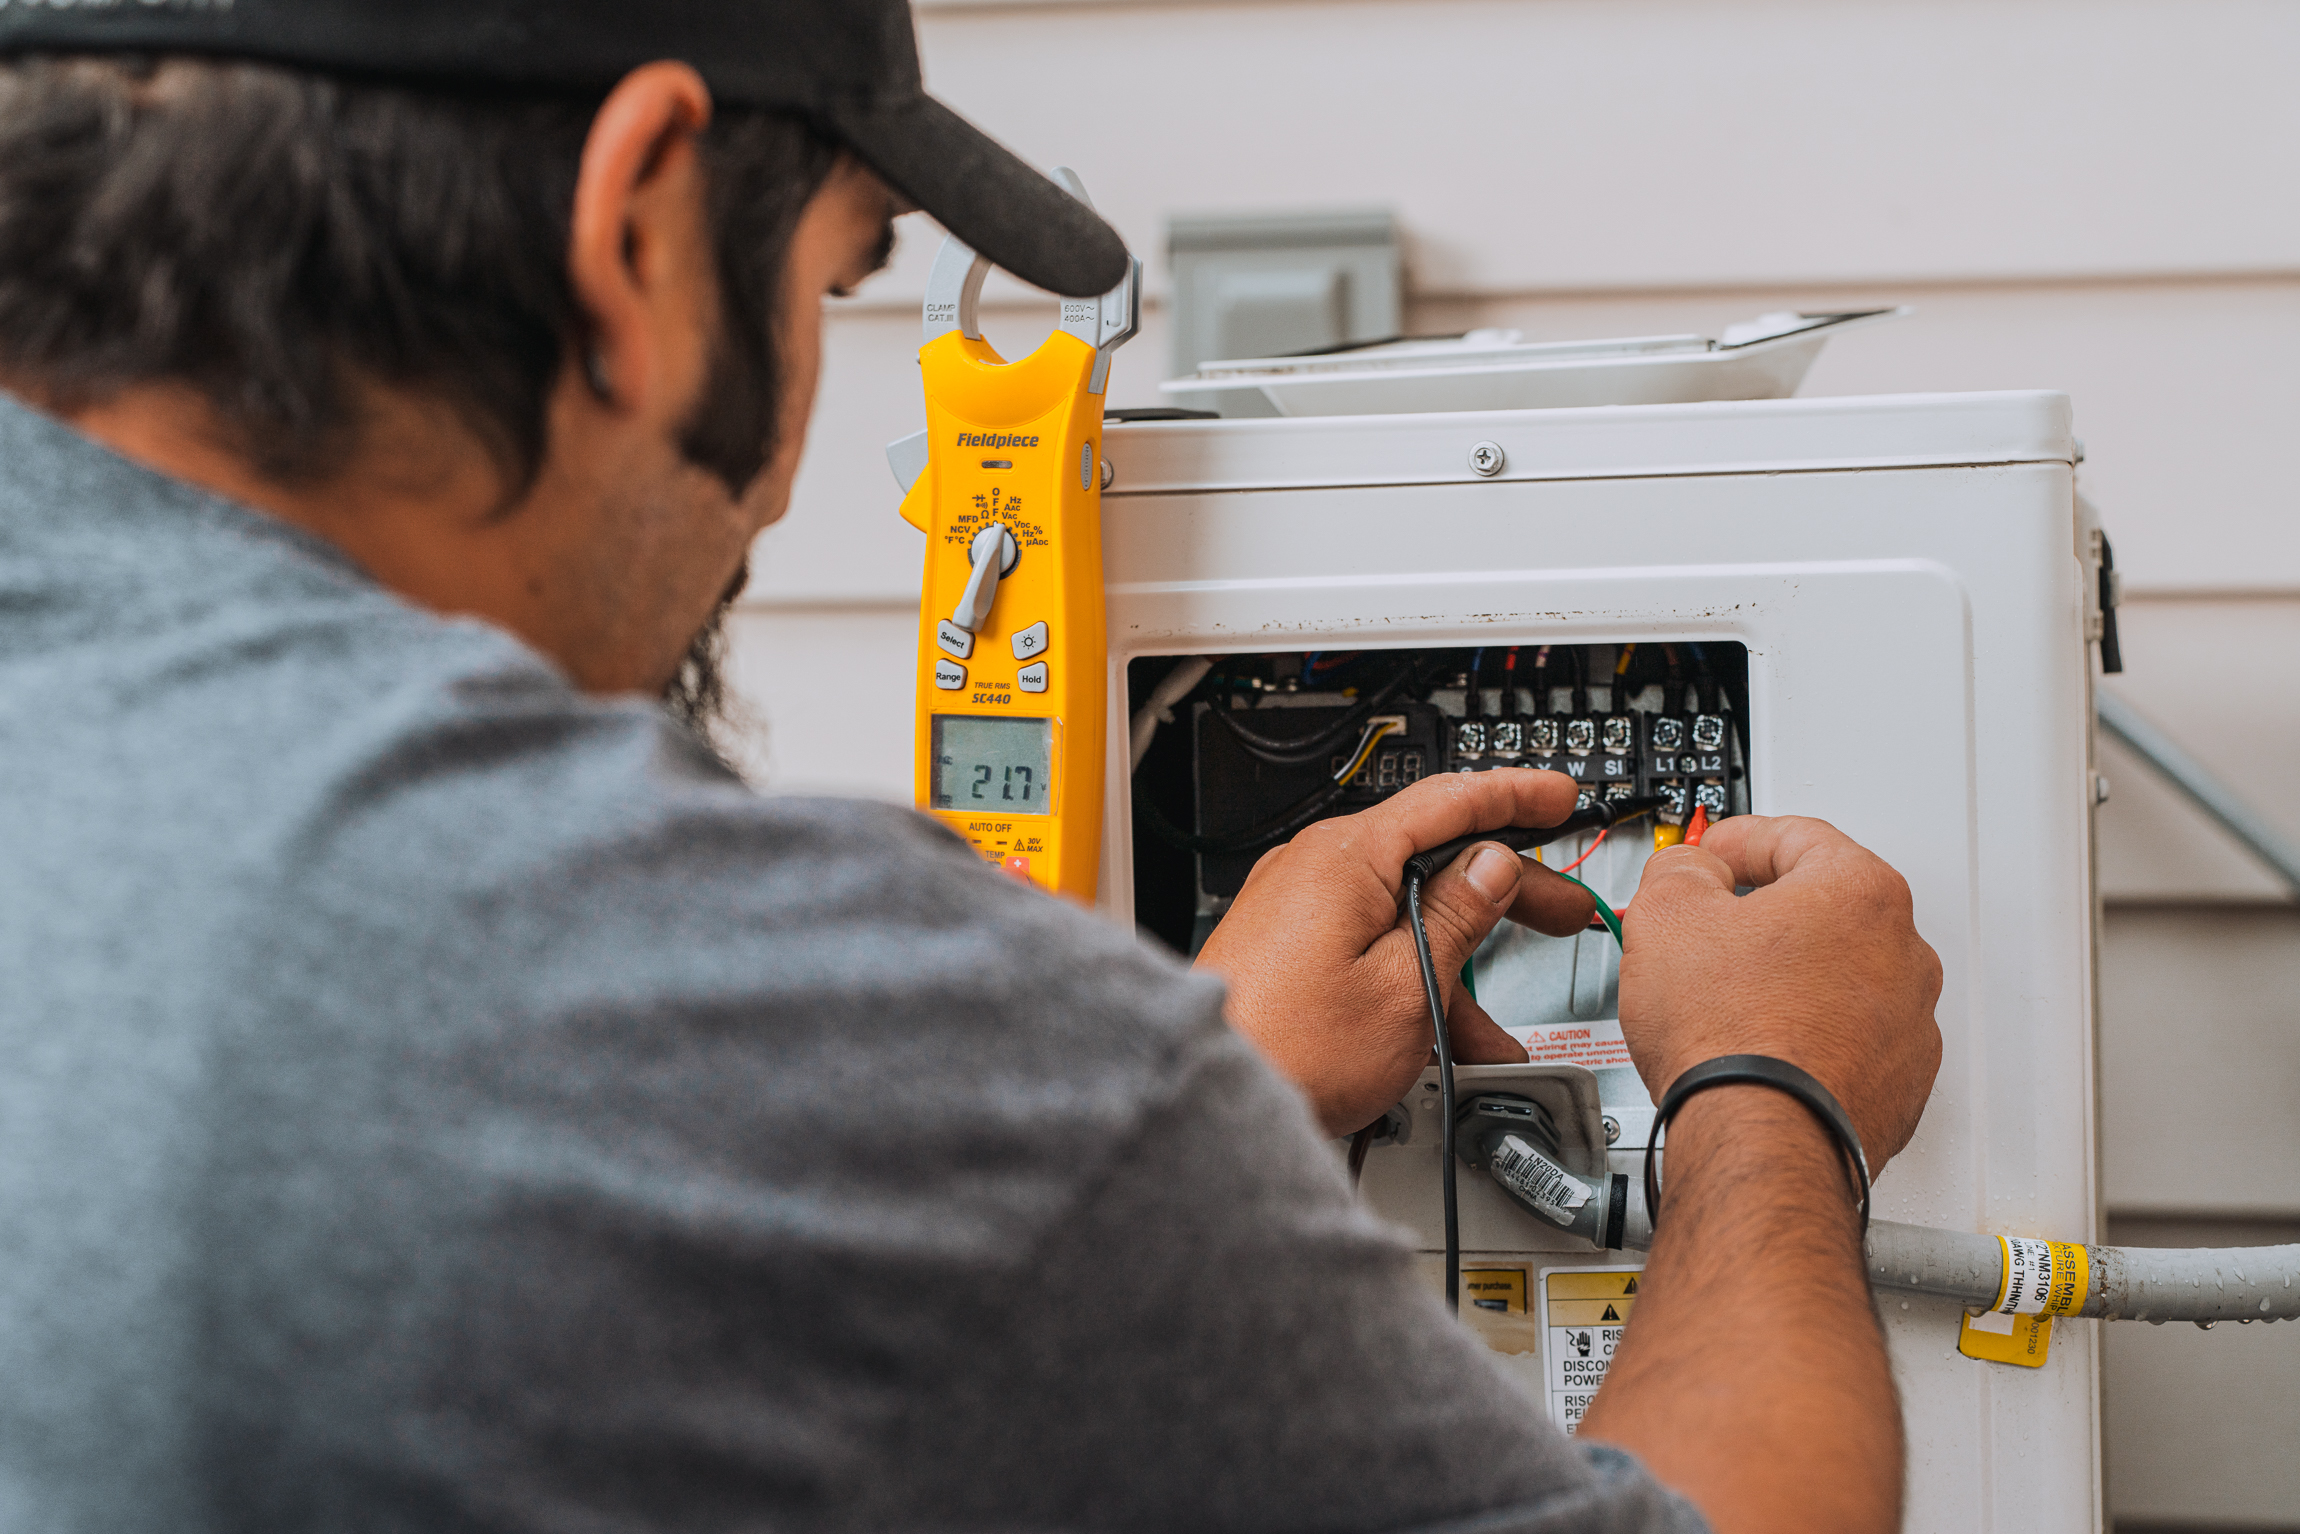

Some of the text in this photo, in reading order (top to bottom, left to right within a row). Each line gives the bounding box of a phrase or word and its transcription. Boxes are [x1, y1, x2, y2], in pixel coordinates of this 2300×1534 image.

[926, 303, 955, 312] CLAMP
[957, 433, 1039, 449] Fieldpiece
[1010, 496, 1021, 504] Hz
[958, 515, 978, 523] MFD
[940, 631, 965, 649] Select
[936, 672, 961, 682] Range
[1022, 675, 1042, 684] Hold
[972, 693, 1011, 704] SC440
[1656, 757, 1675, 772] L1
[1701, 756, 1722, 770] L2
[1567, 761, 1586, 777] W
[968, 822, 1012, 832] AUTO OFF
[985, 850, 1005, 859] TEMP
[1549, 1029, 1591, 1041] CAUTION
[1536, 1043, 1567, 1052] wiring
[1570, 1041, 1592, 1049] may
[1595, 1039, 1626, 1047] cause
[1543, 1051, 1584, 1060] operate
[1568, 1058, 1603, 1066] lectric
[1528, 1153, 1564, 1182] LN20DA
[2054, 1243, 2076, 1317] ASSEMBLI
[2050, 1283, 2063, 1311] WHIP
